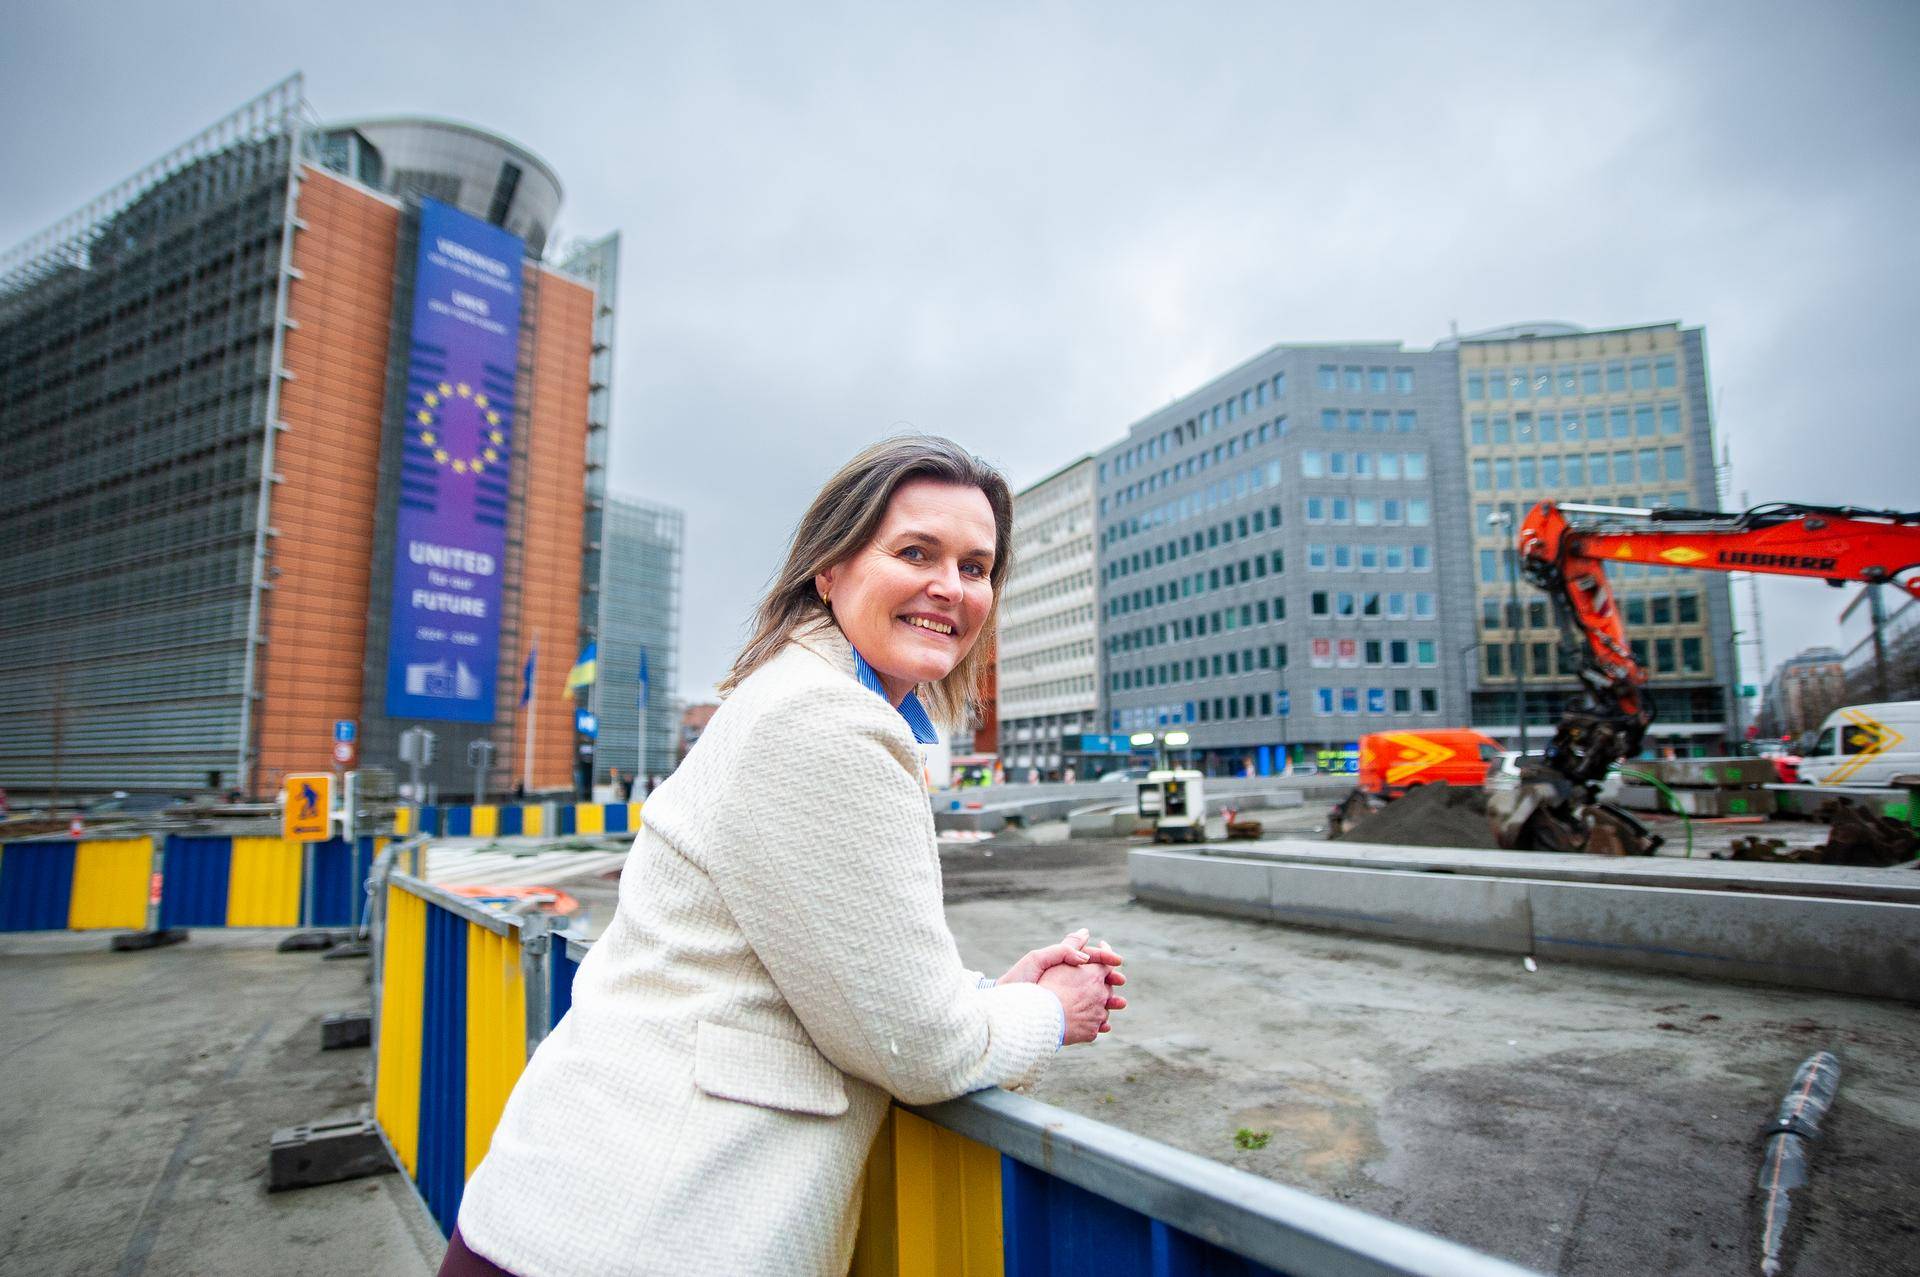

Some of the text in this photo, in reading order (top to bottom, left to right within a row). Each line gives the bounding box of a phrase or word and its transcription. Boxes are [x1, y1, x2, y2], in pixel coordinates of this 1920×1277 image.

[409, 540, 496, 576] UNITED
[1718, 550, 1837, 571] LIEBHERR
[412, 589, 488, 619] FUTURE
